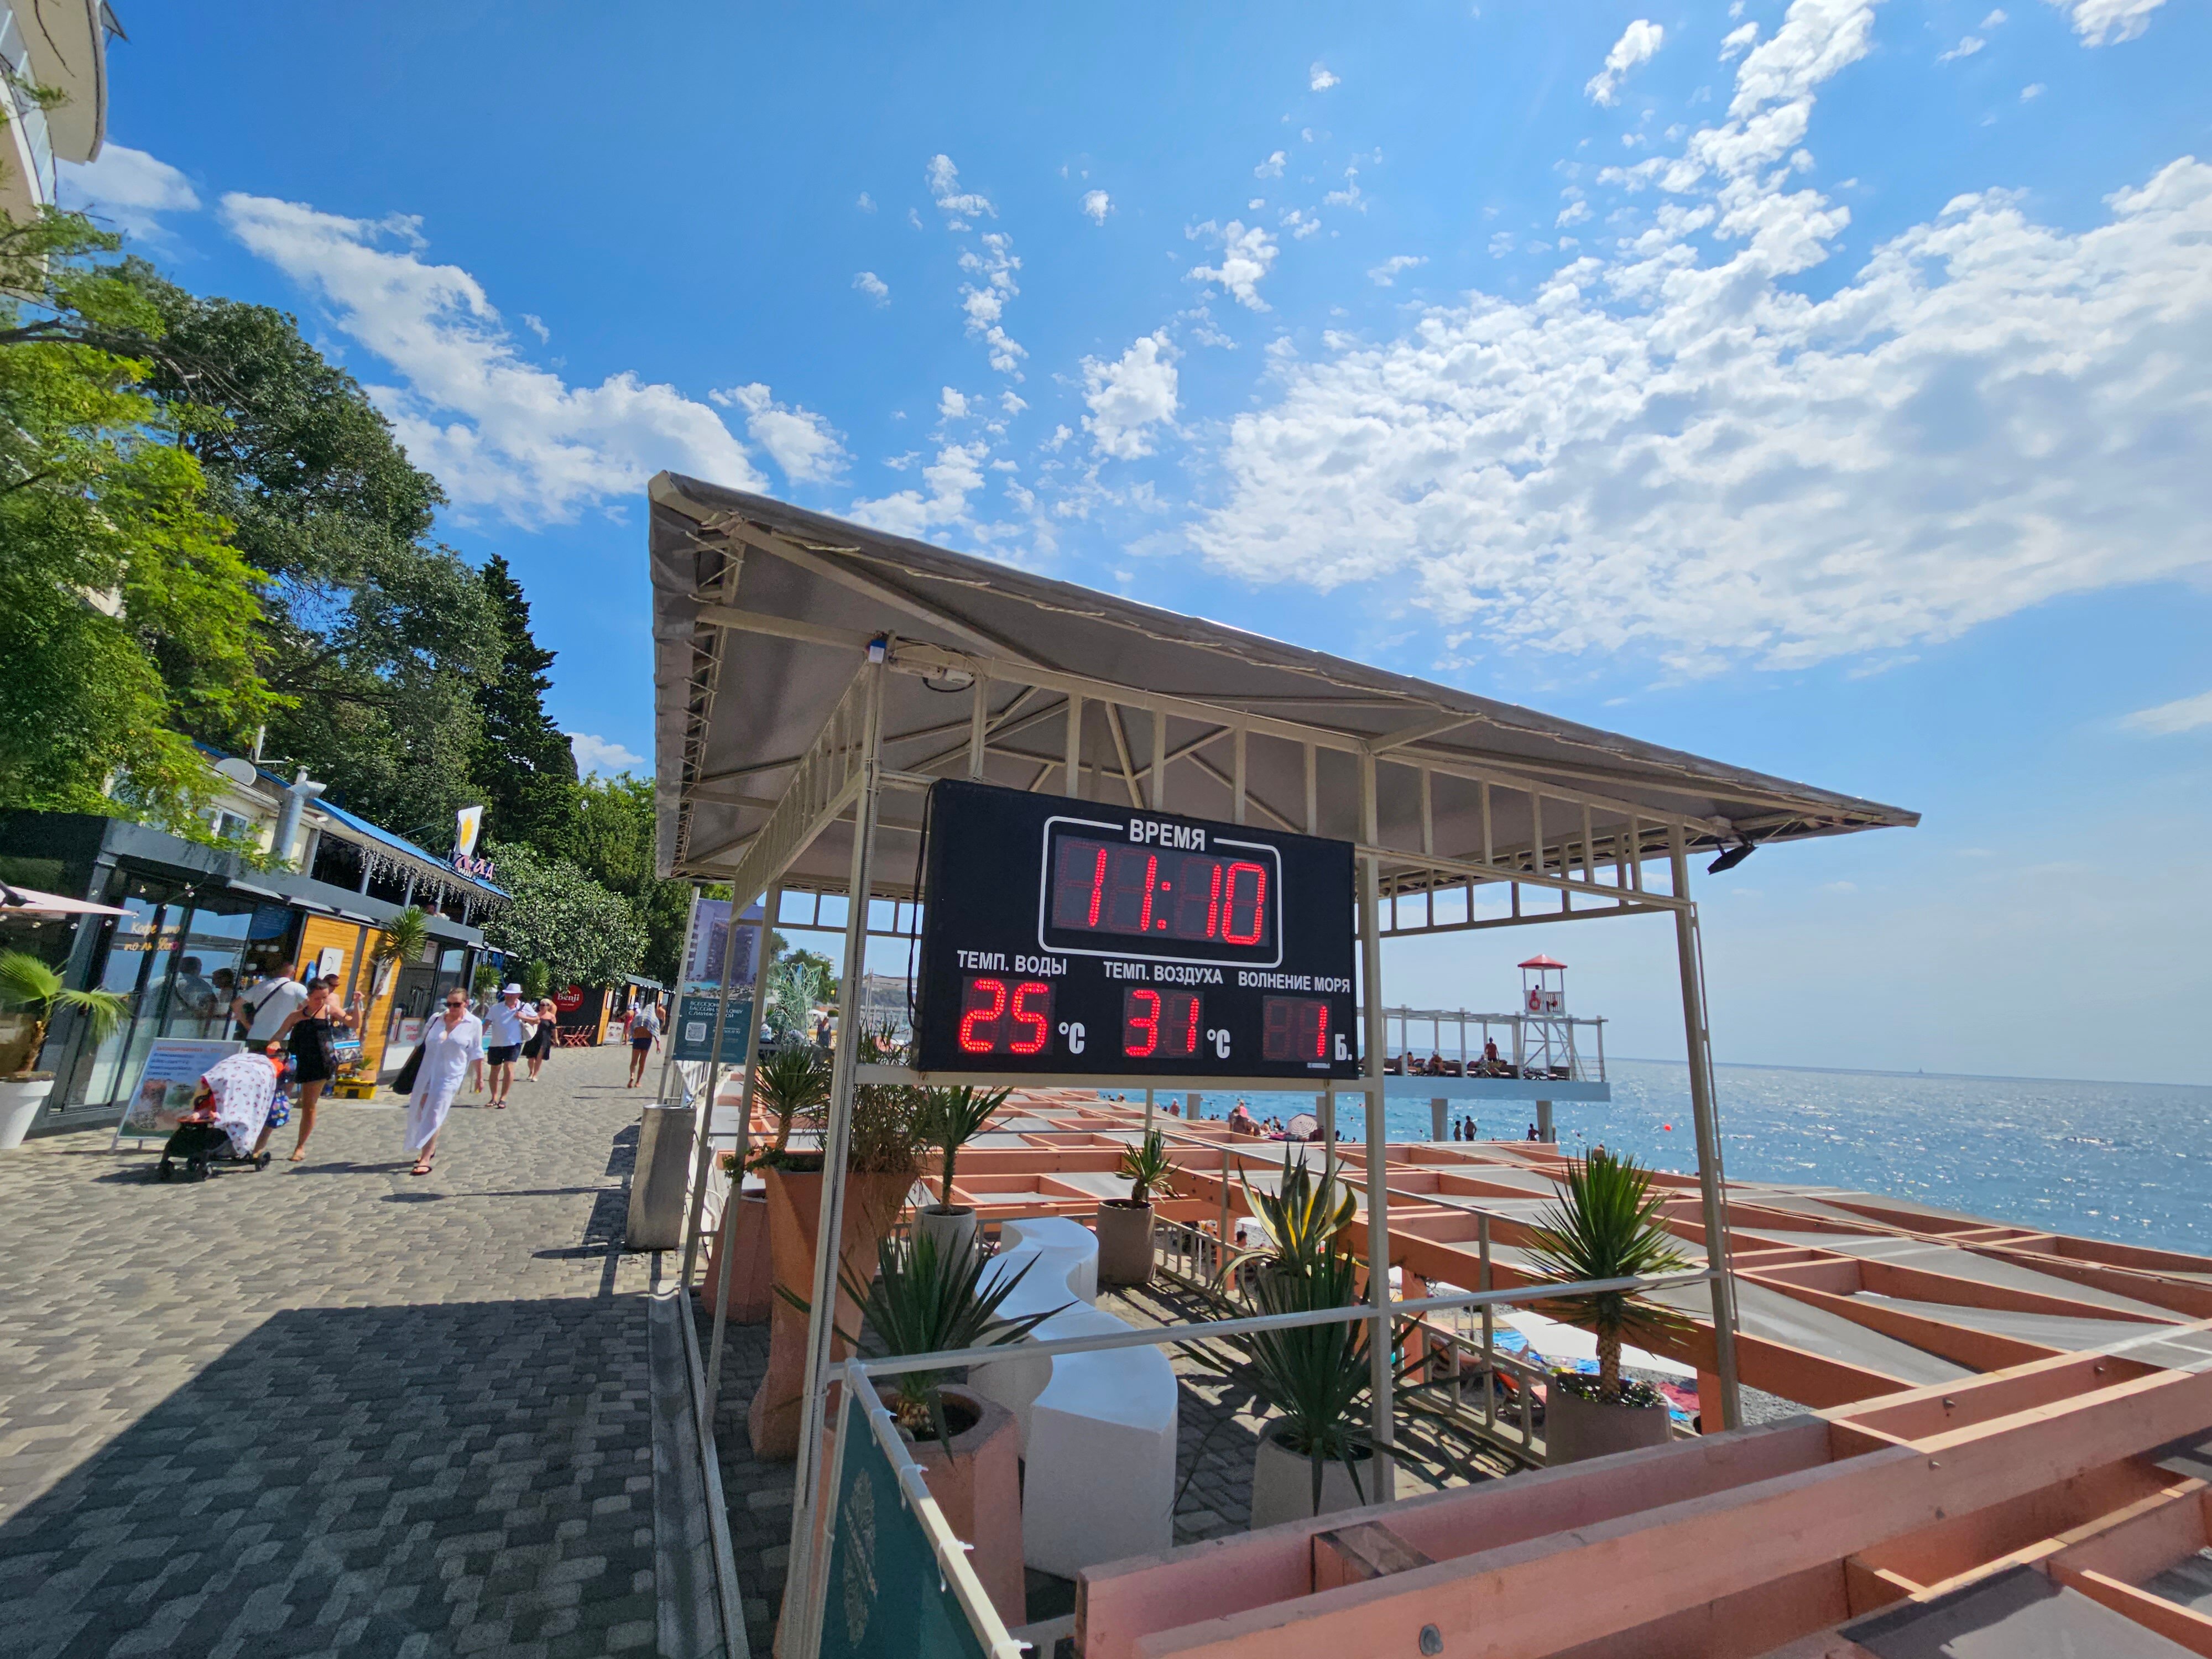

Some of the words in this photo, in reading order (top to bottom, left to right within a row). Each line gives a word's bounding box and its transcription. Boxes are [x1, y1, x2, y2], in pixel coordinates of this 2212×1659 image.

[1130, 818, 1205, 851] ВРЕМЯ
[1088, 847, 1267, 946] 11:10
[957, 950, 1009, 972] ТЕМП.
[1015, 954, 1067, 977] ВОДЫ
[1103, 961, 1150, 980] ТЕМП.
[1154, 965, 1224, 985] ВОЗДУХА
[557, 993, 580, 1003] Benji
[1238, 971, 1311, 991] ВОЛНЕНИЕ
[1314, 977, 1350, 993] МОРЯ
[959, 978, 1049, 1053] 25
[1125, 989, 1200, 1057] 31
[1317, 1005, 1328, 1058] 1
[1334, 1034, 1353, 1061] Б.
